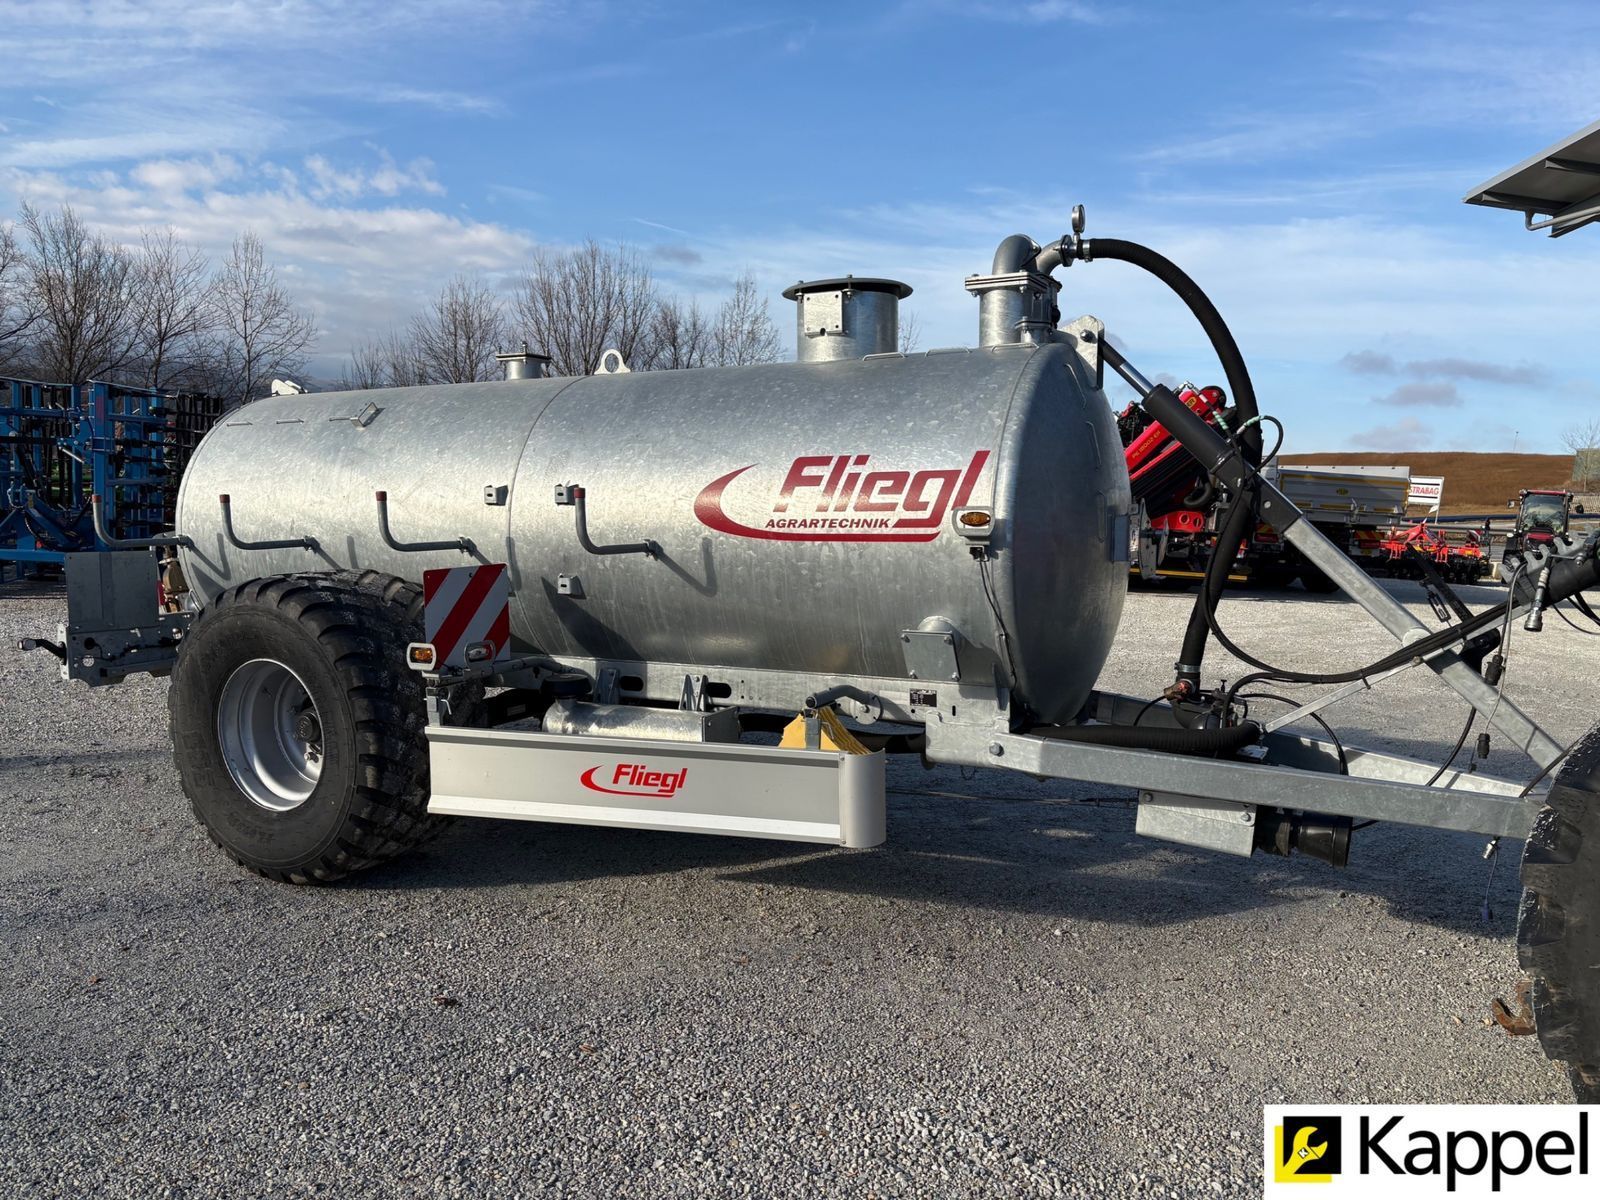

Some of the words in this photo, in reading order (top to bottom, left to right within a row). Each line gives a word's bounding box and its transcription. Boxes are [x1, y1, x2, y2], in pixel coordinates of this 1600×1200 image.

[773, 450, 990, 528] Fliegl
[765, 518, 892, 529] AGRARTECHNIK
[612, 763, 688, 793] Fliegl
